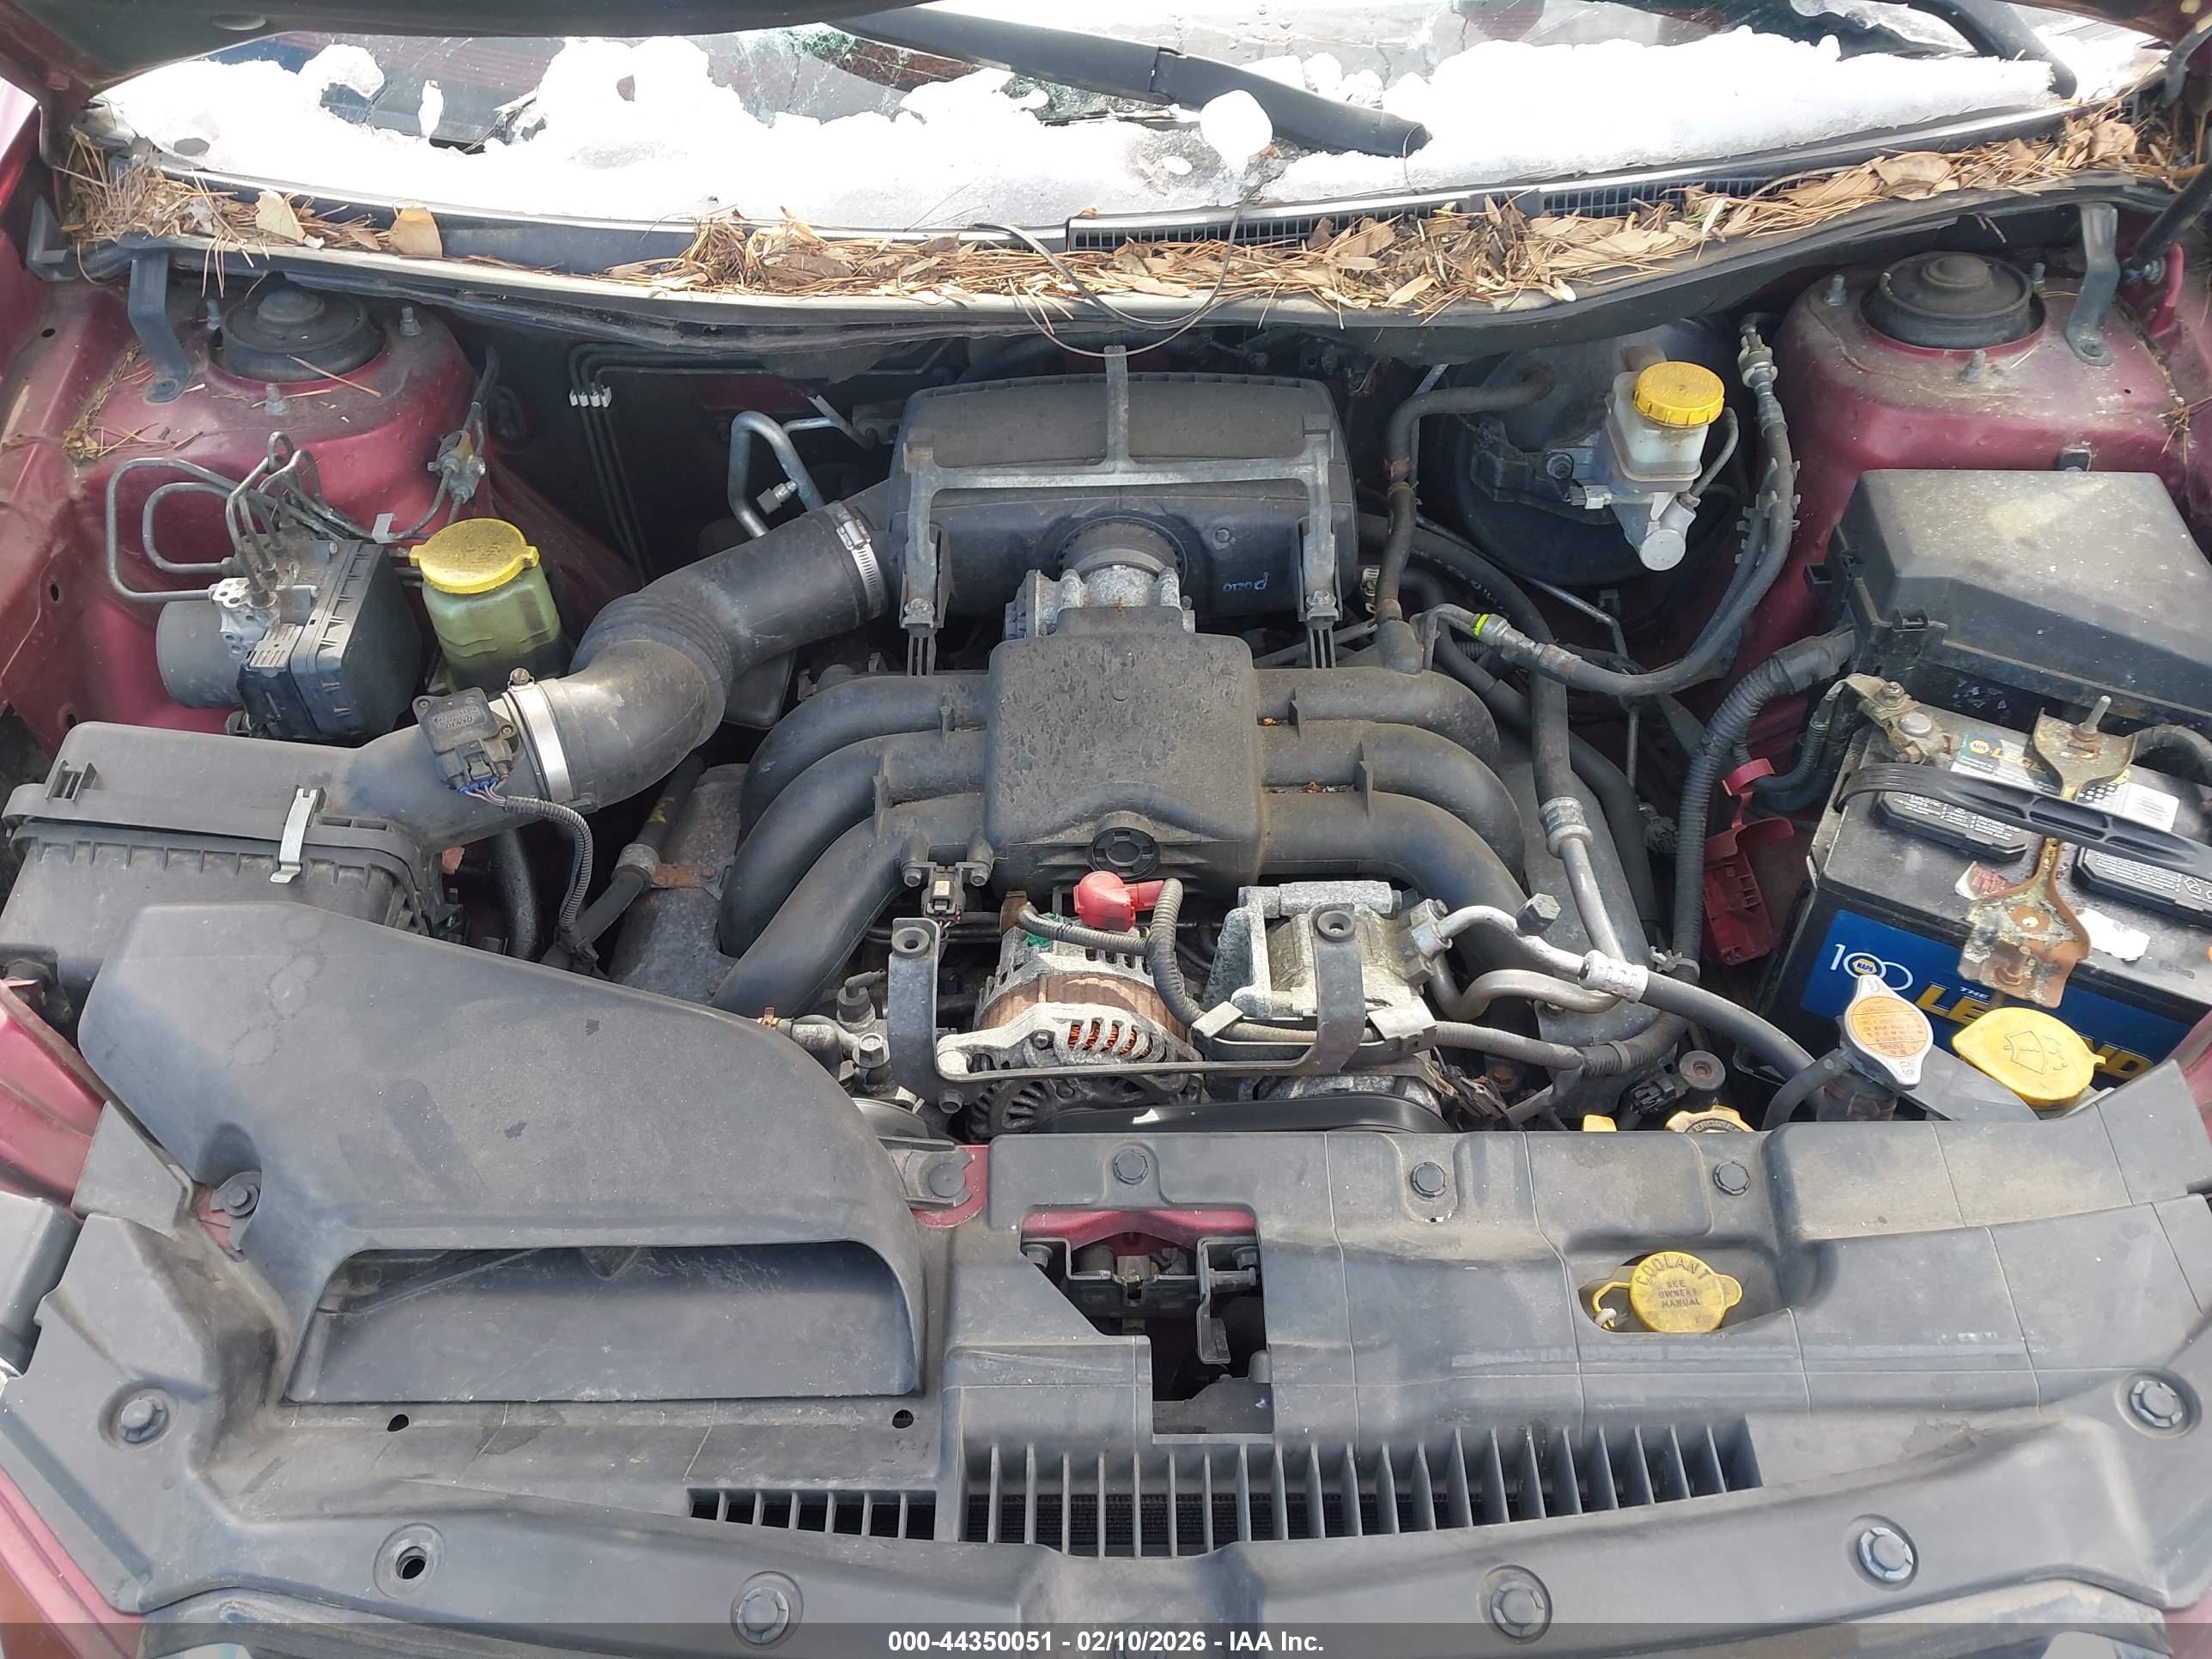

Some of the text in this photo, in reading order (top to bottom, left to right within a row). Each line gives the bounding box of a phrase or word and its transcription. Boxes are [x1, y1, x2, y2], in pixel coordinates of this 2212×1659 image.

[1856, 960, 1875, 974] NAPA
[1959, 985, 1992, 1000] THE
[1635, 1255, 1712, 1285] COOLANT
[1662, 1298, 1701, 1309] MANUAL
